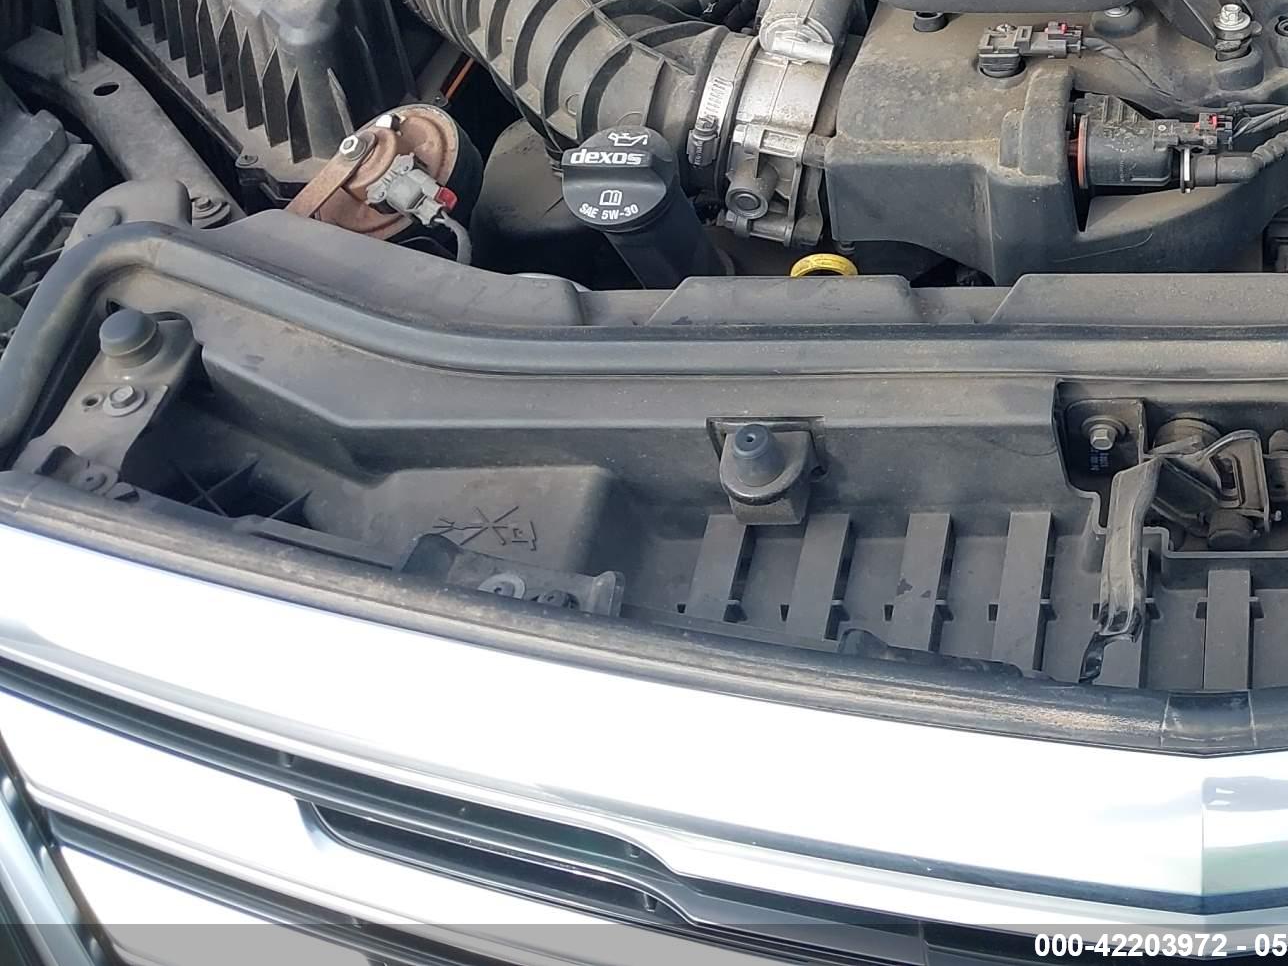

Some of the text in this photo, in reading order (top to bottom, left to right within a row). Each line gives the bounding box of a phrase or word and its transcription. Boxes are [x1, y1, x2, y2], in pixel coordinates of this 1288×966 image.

[570, 148, 646, 165] dexos
[579, 203, 639, 220] SAE 5W-30
